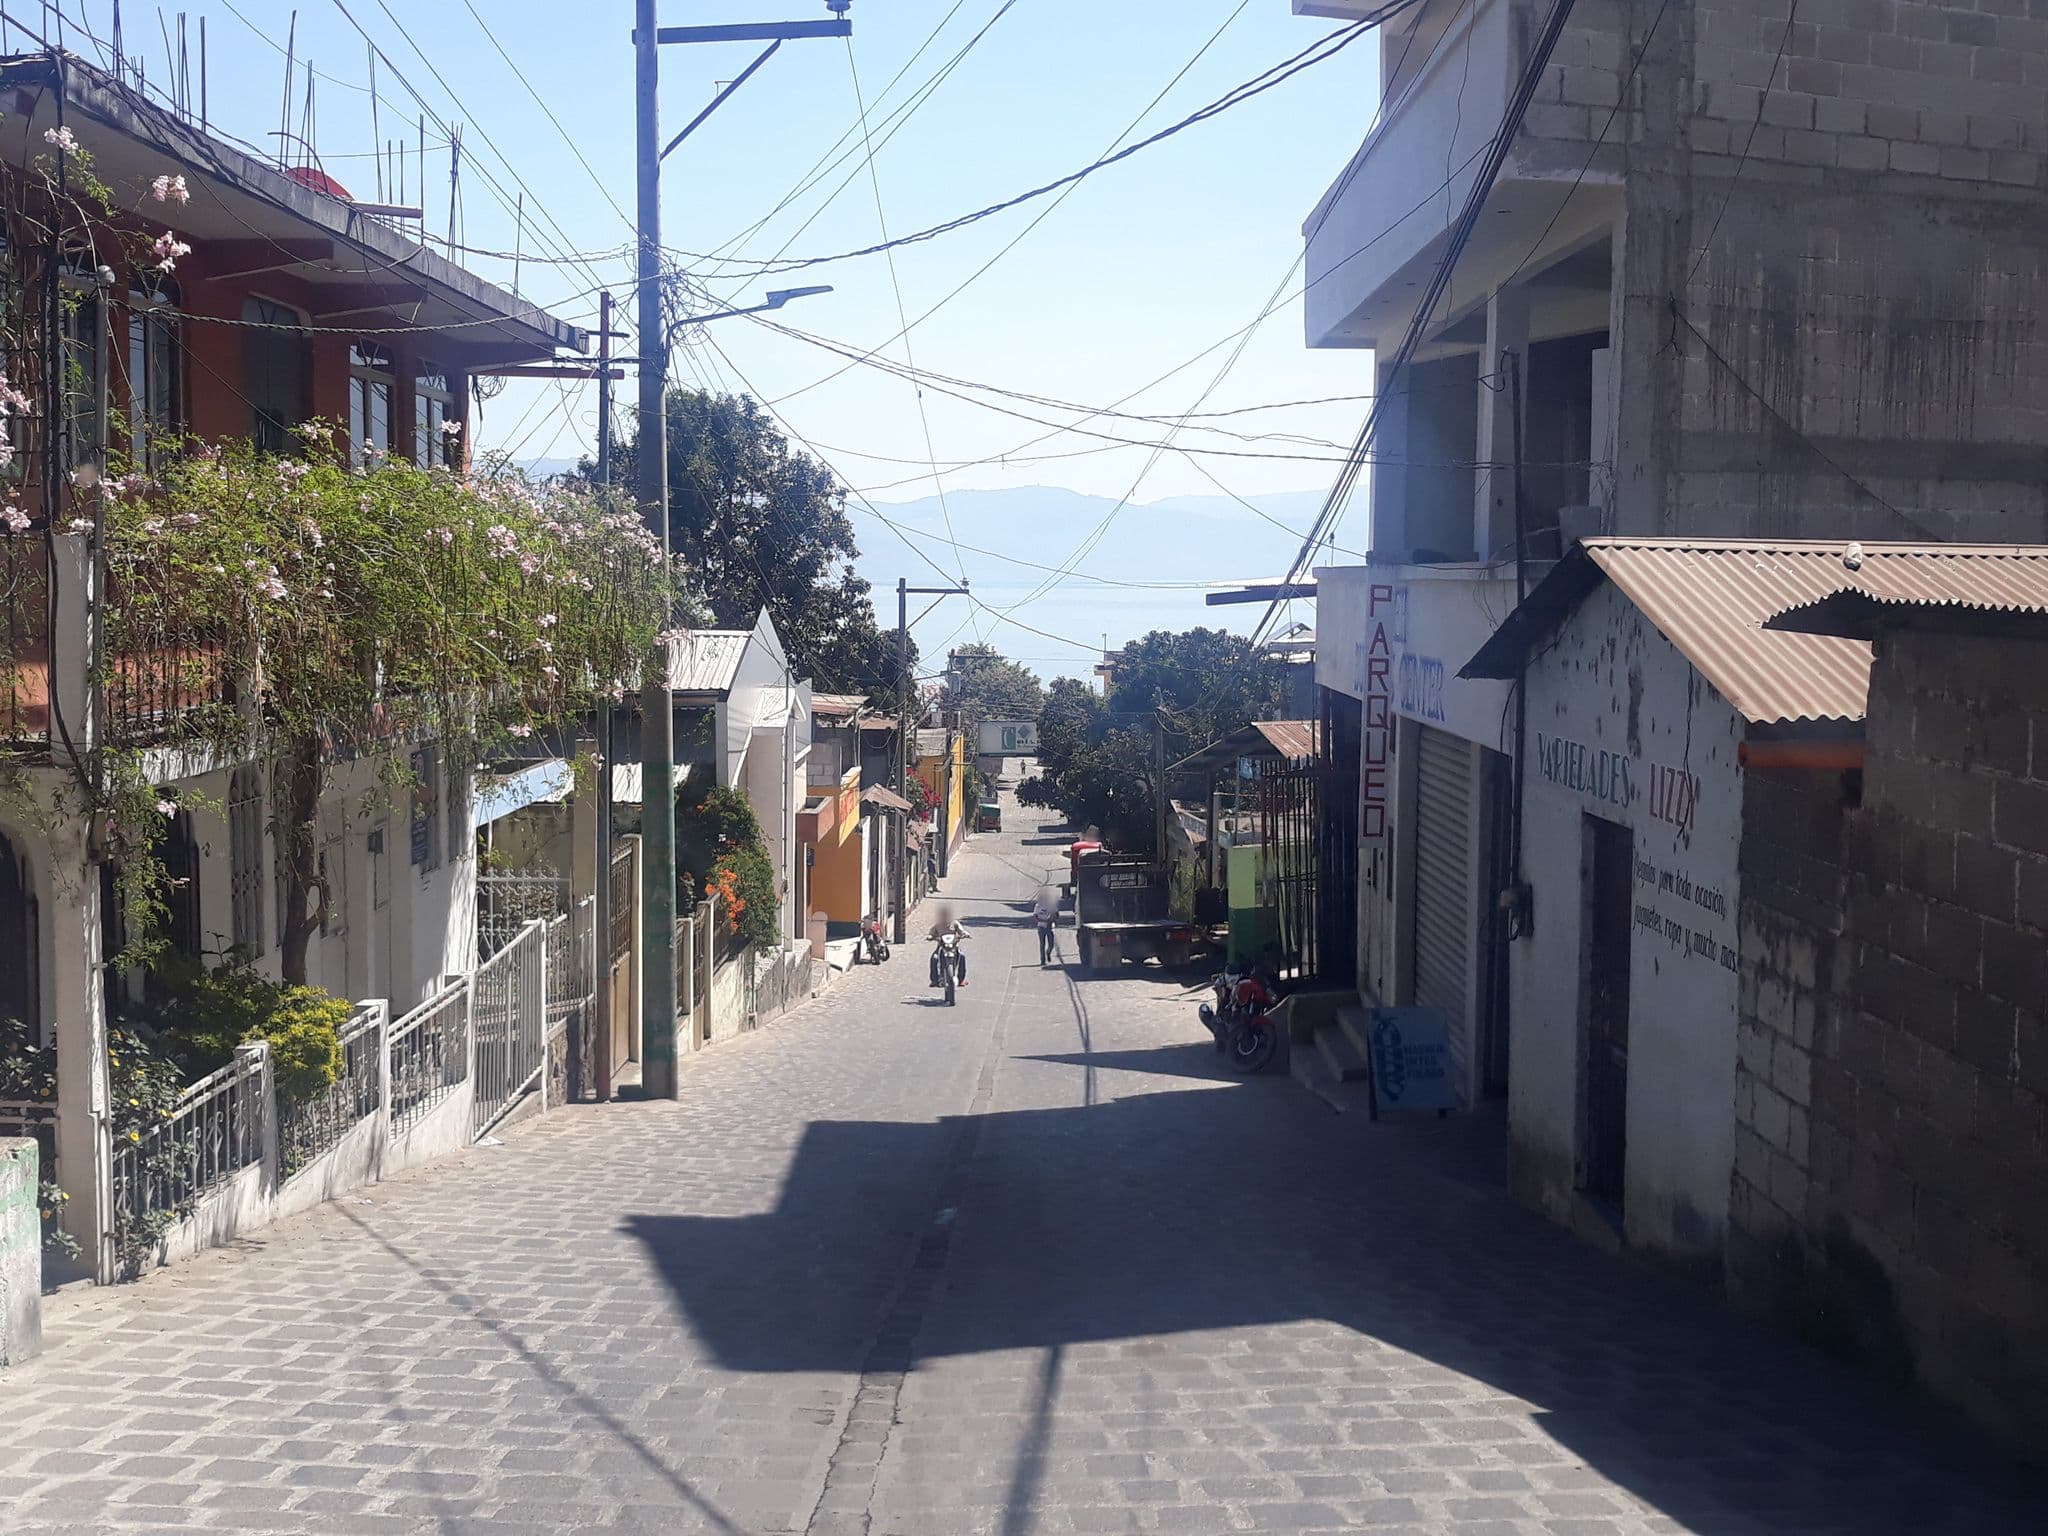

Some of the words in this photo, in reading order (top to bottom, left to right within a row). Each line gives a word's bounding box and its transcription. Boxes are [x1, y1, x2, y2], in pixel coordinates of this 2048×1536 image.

[1364, 584, 1392, 837] PARQUEO
[1537, 732, 1630, 809] VARIEDADES
[1649, 763, 1701, 830] LIZZY
[1657, 870, 1674, 895] para
[1675, 869, 1692, 901] toda
[1664, 918, 1682, 950] ropa
[1693, 930, 1717, 962] mucho
